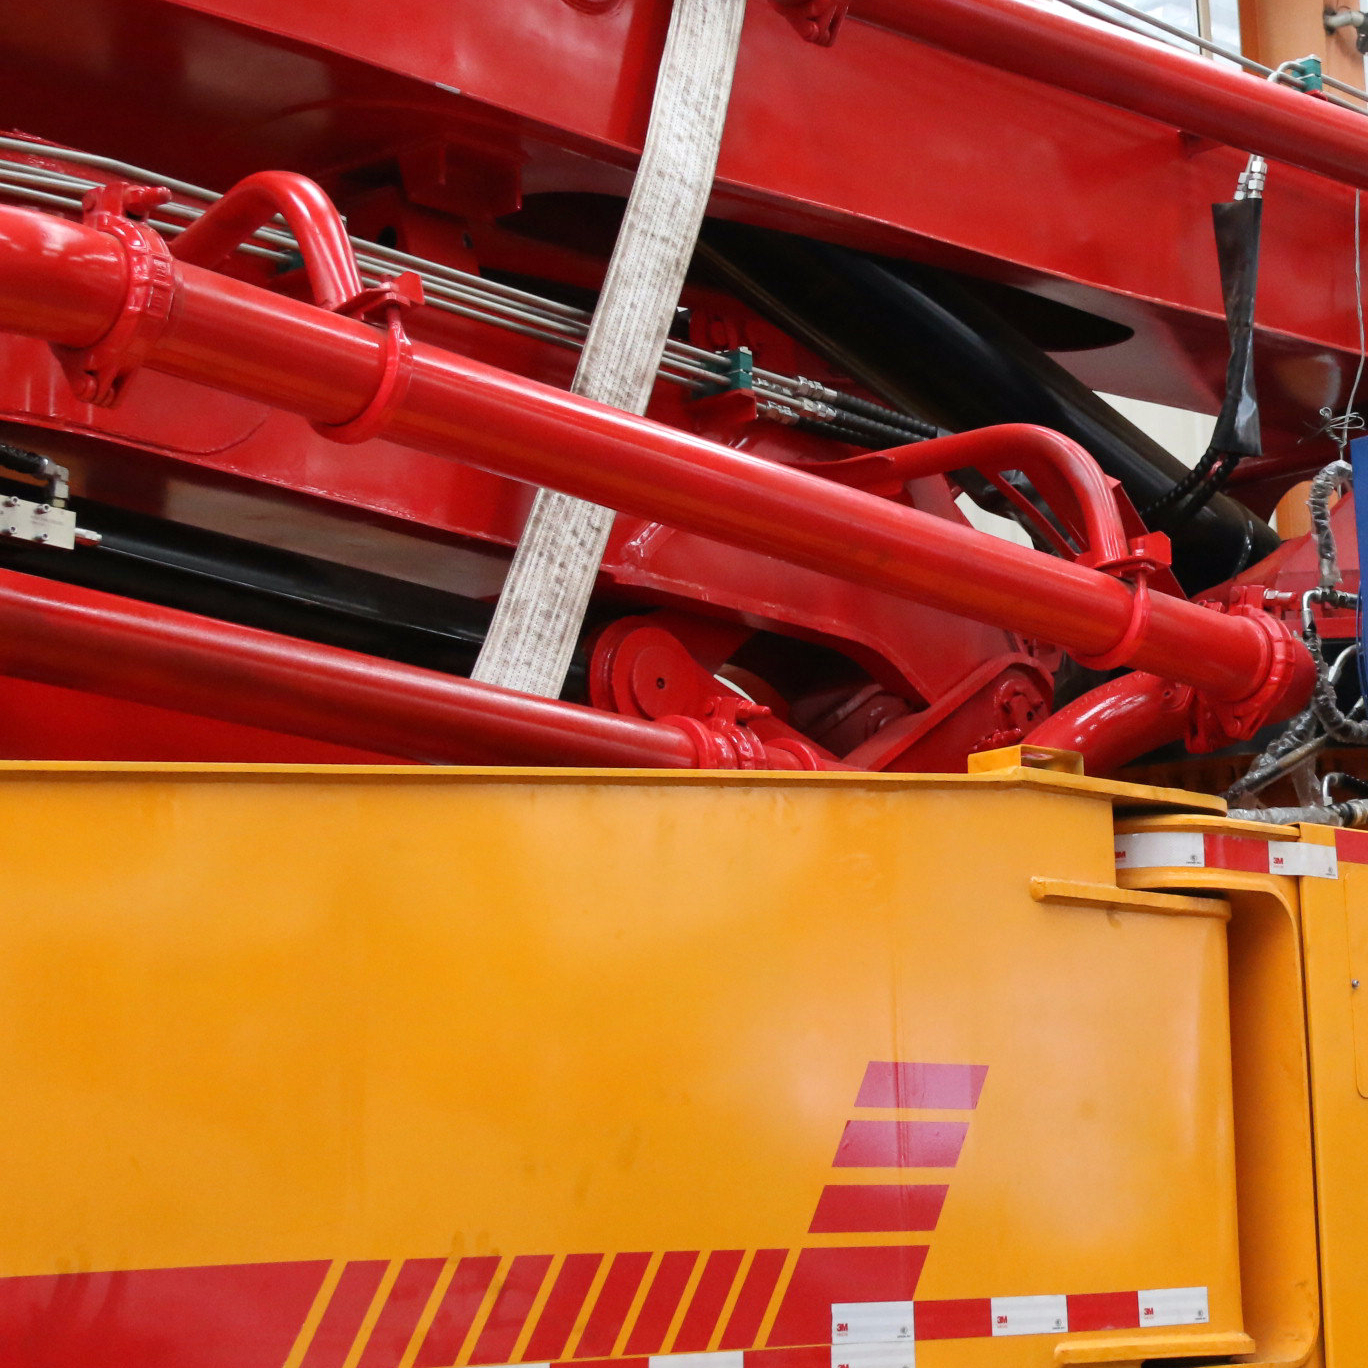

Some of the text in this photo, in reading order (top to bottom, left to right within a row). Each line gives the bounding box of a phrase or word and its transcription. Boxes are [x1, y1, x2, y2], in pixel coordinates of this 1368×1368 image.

[1273, 857, 1284, 865] 3M
[1143, 1307, 1154, 1315] 3M
[996, 1315, 1008, 1324] 3M
[836, 1323, 848, 1332] 3M
